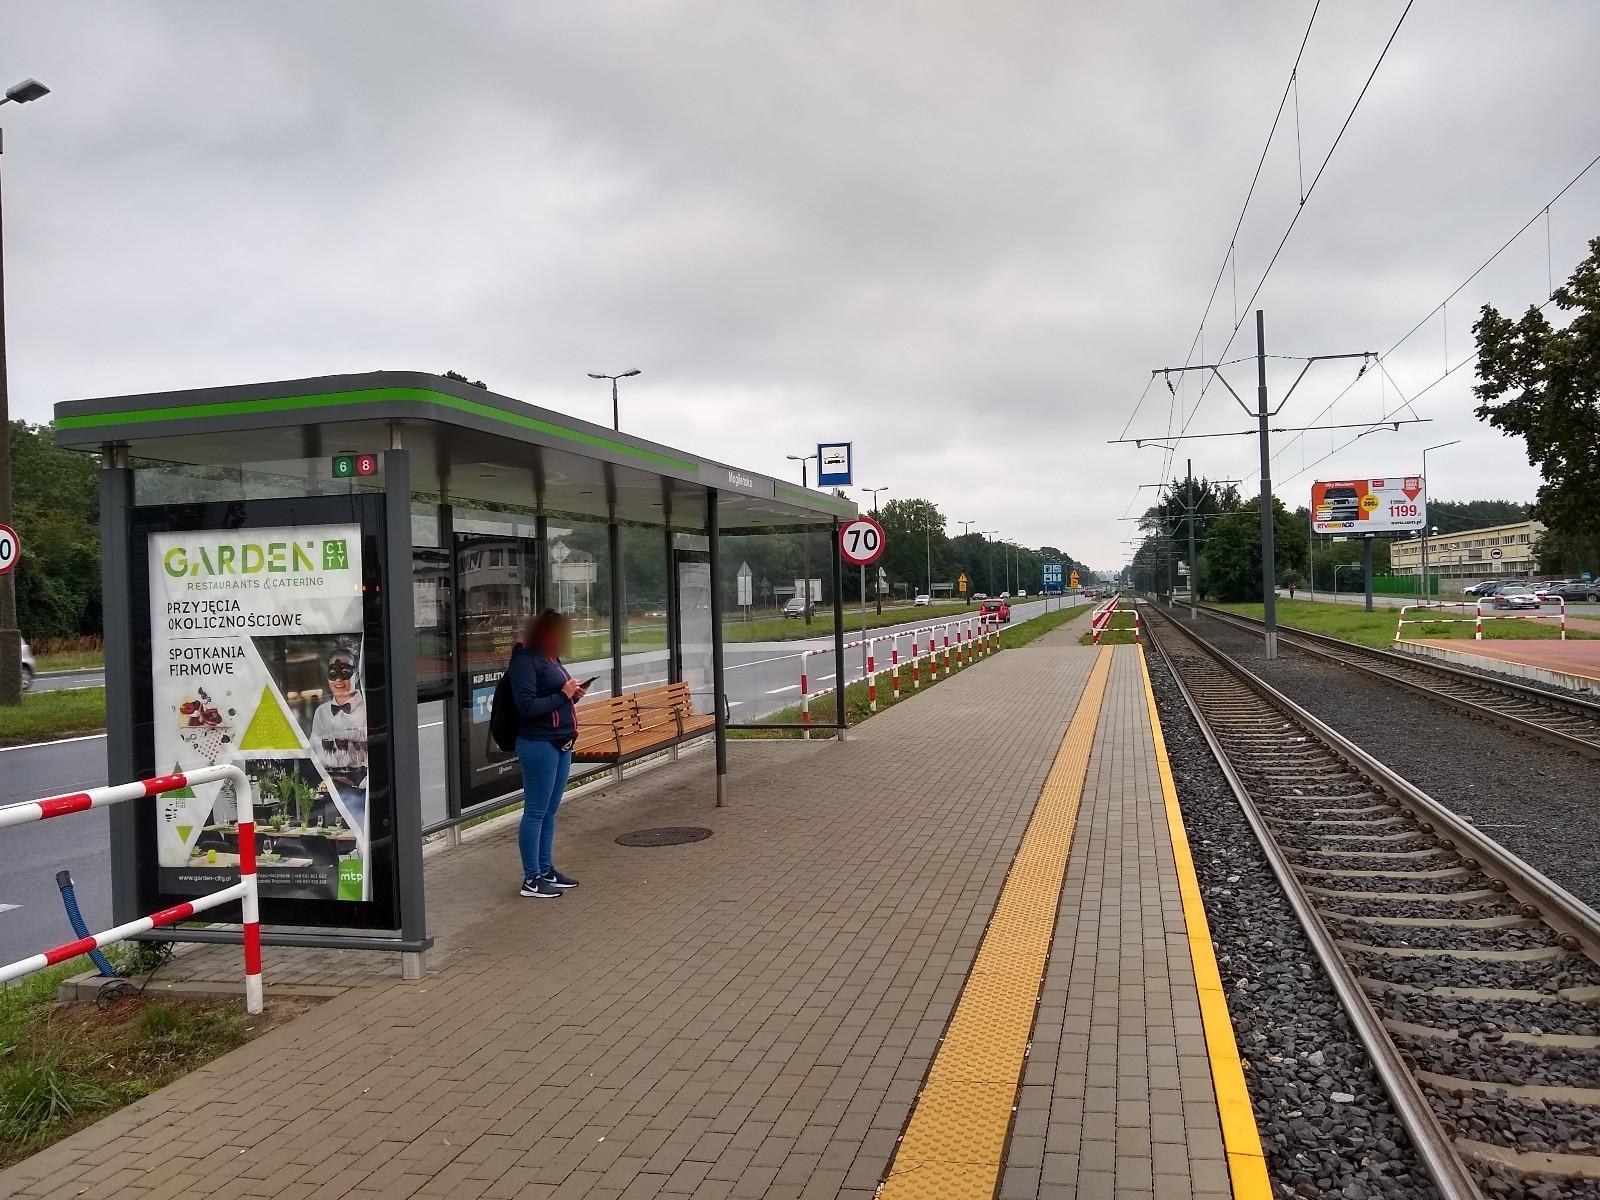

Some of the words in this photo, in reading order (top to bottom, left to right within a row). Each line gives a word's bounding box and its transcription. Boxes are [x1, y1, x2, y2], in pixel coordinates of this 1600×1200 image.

[340, 461, 347, 472] 6
[362, 459, 370, 471] 8
[1388, 505, 1417, 517] 1199
[848, 529, 878, 552] 70
[0, 539, 11, 560] 0
[163, 541, 314, 578] GARDEN
[187, 579, 260, 591] RESTAURANTS
[272, 577, 324, 588] CATERING
[167, 600, 241, 615] PRZYJĘCIA
[168, 613, 302, 630] OKOLICZNOŚCIOWE
[169, 646, 246, 661] SPOTKANIA
[170, 662, 234, 676] FIRMOWE
[340, 873, 363, 883] mtp
